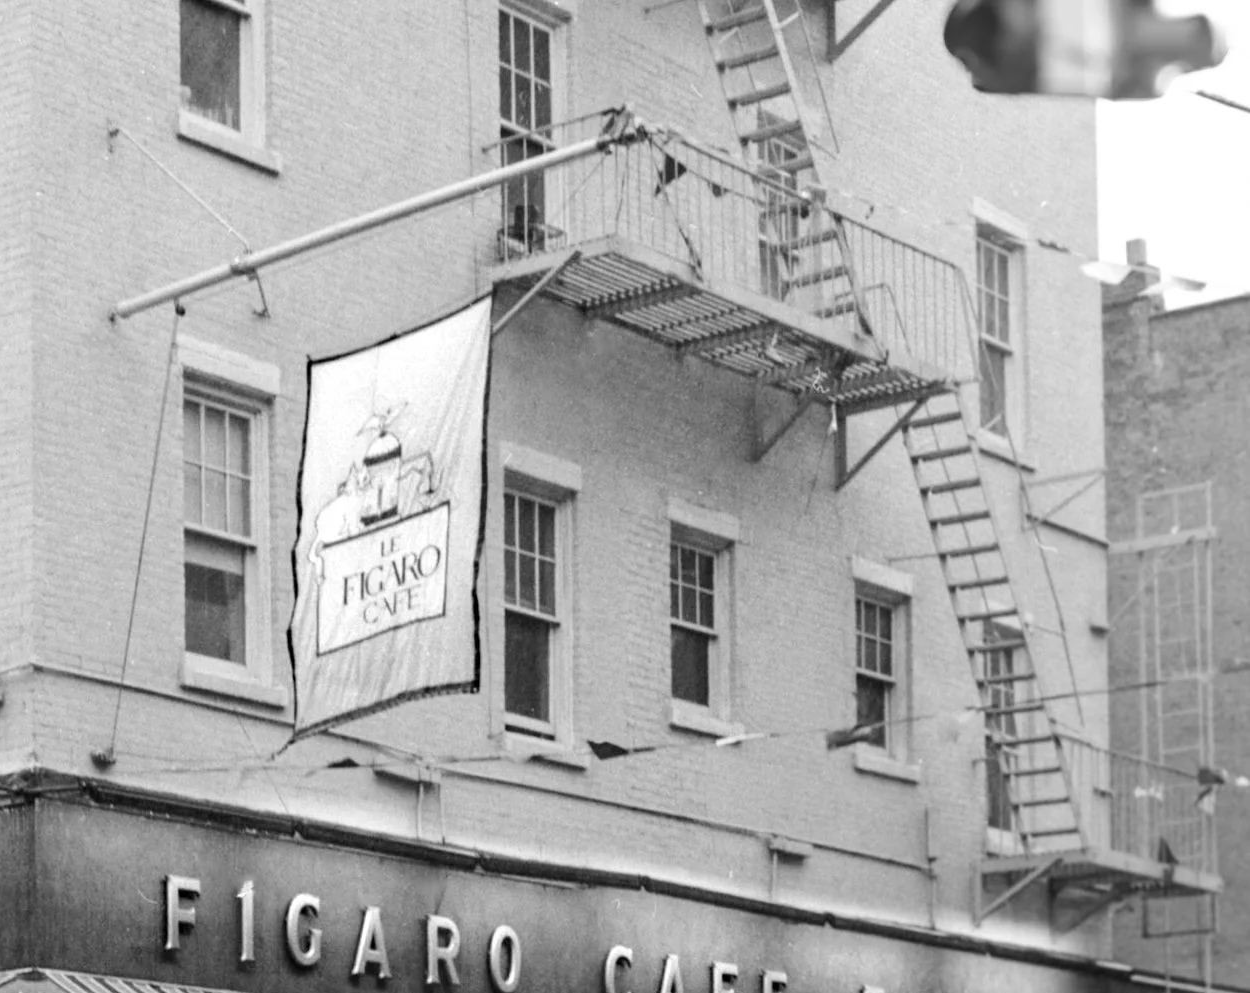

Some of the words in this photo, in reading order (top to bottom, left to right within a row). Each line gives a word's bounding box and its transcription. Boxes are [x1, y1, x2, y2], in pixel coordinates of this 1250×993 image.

[380, 536, 402, 558] LE
[342, 544, 441, 606] FIGARO
[363, 583, 423, 624] CAFE
